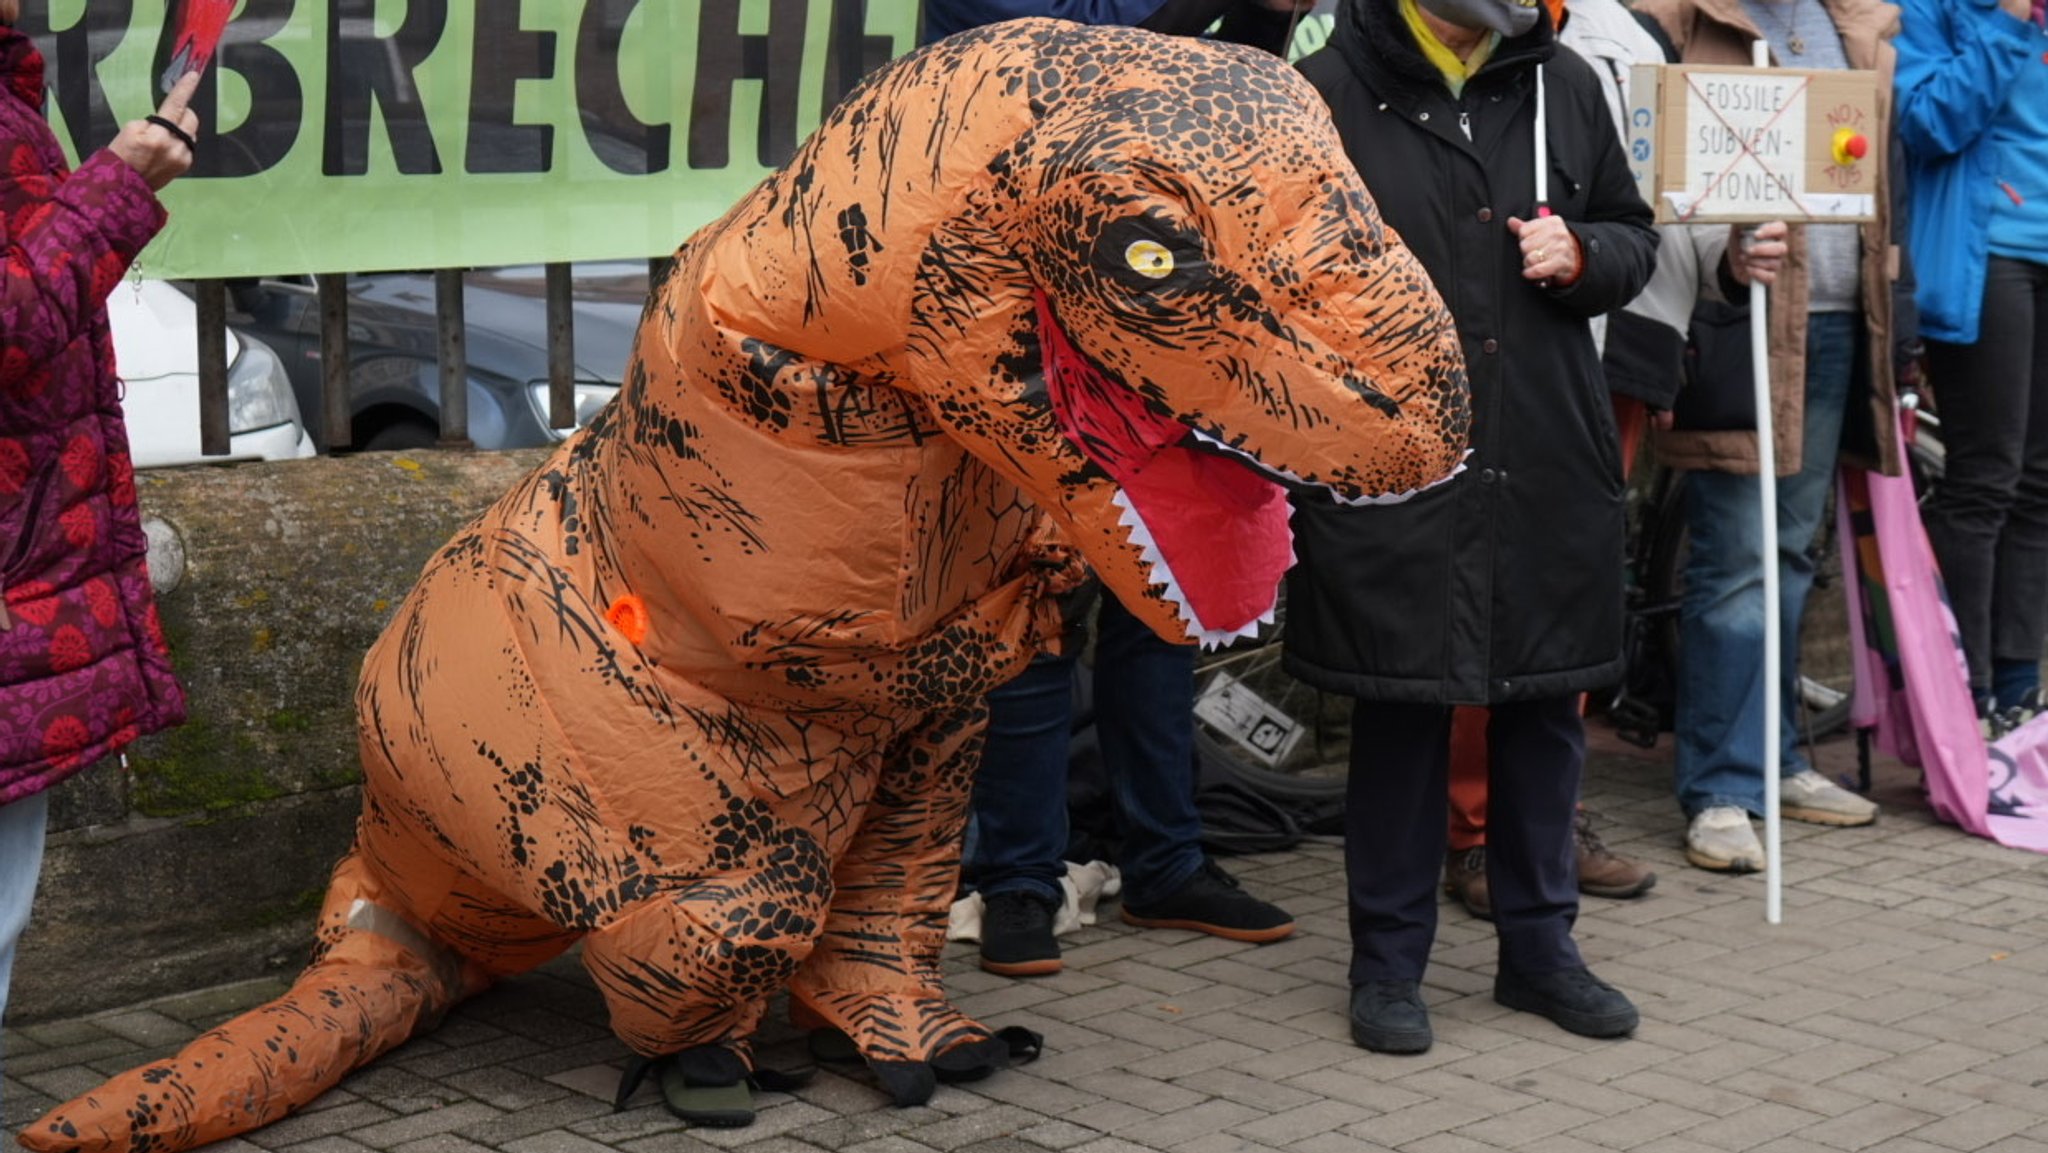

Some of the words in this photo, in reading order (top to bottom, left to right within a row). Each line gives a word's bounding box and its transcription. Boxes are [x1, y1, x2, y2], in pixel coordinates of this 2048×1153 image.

[1706, 82, 1783, 112] FOSSILE
[1698, 125, 1792, 155] SUBVEN-
[1702, 171, 1796, 201] TIONEN
